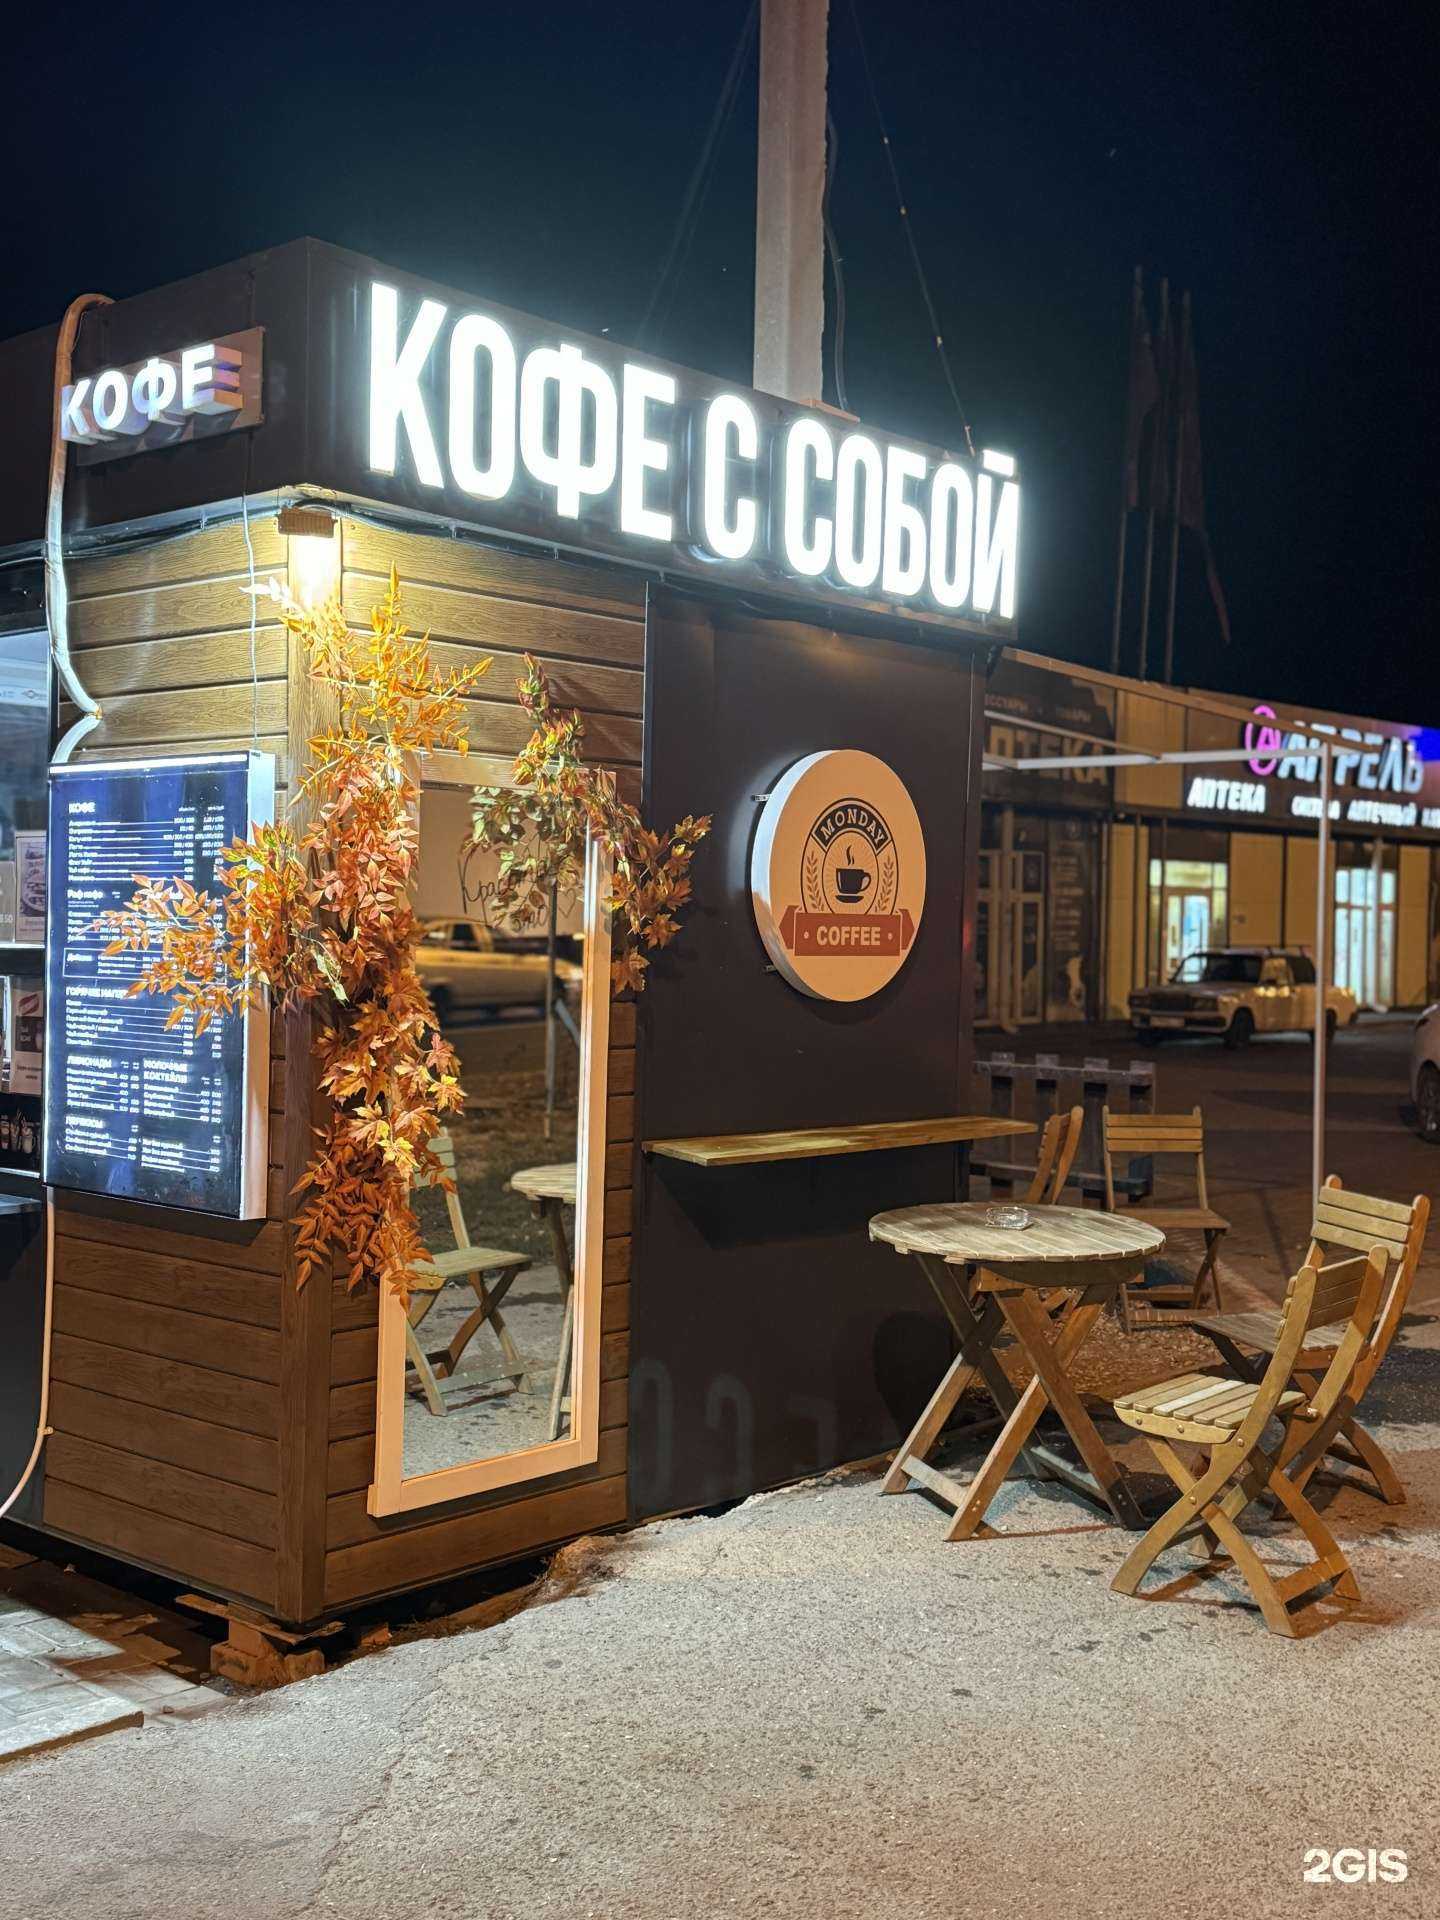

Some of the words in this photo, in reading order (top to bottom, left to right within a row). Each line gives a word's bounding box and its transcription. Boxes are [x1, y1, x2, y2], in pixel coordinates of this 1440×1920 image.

[61, 343, 218, 440] КОФЕ
[369, 280, 676, 542] КОФЕ
[704, 394, 757, 559] С
[784, 417, 1020, 620] СОБОЙ
[989, 725, 1109, 786] ПТЕКА
[1186, 776, 1267, 814] АПТЕКА
[821, 808, 885, 844] MONDAY
[816, 925, 881, 946] COFFEE
[101, 989, 136, 999] НАПИТ
